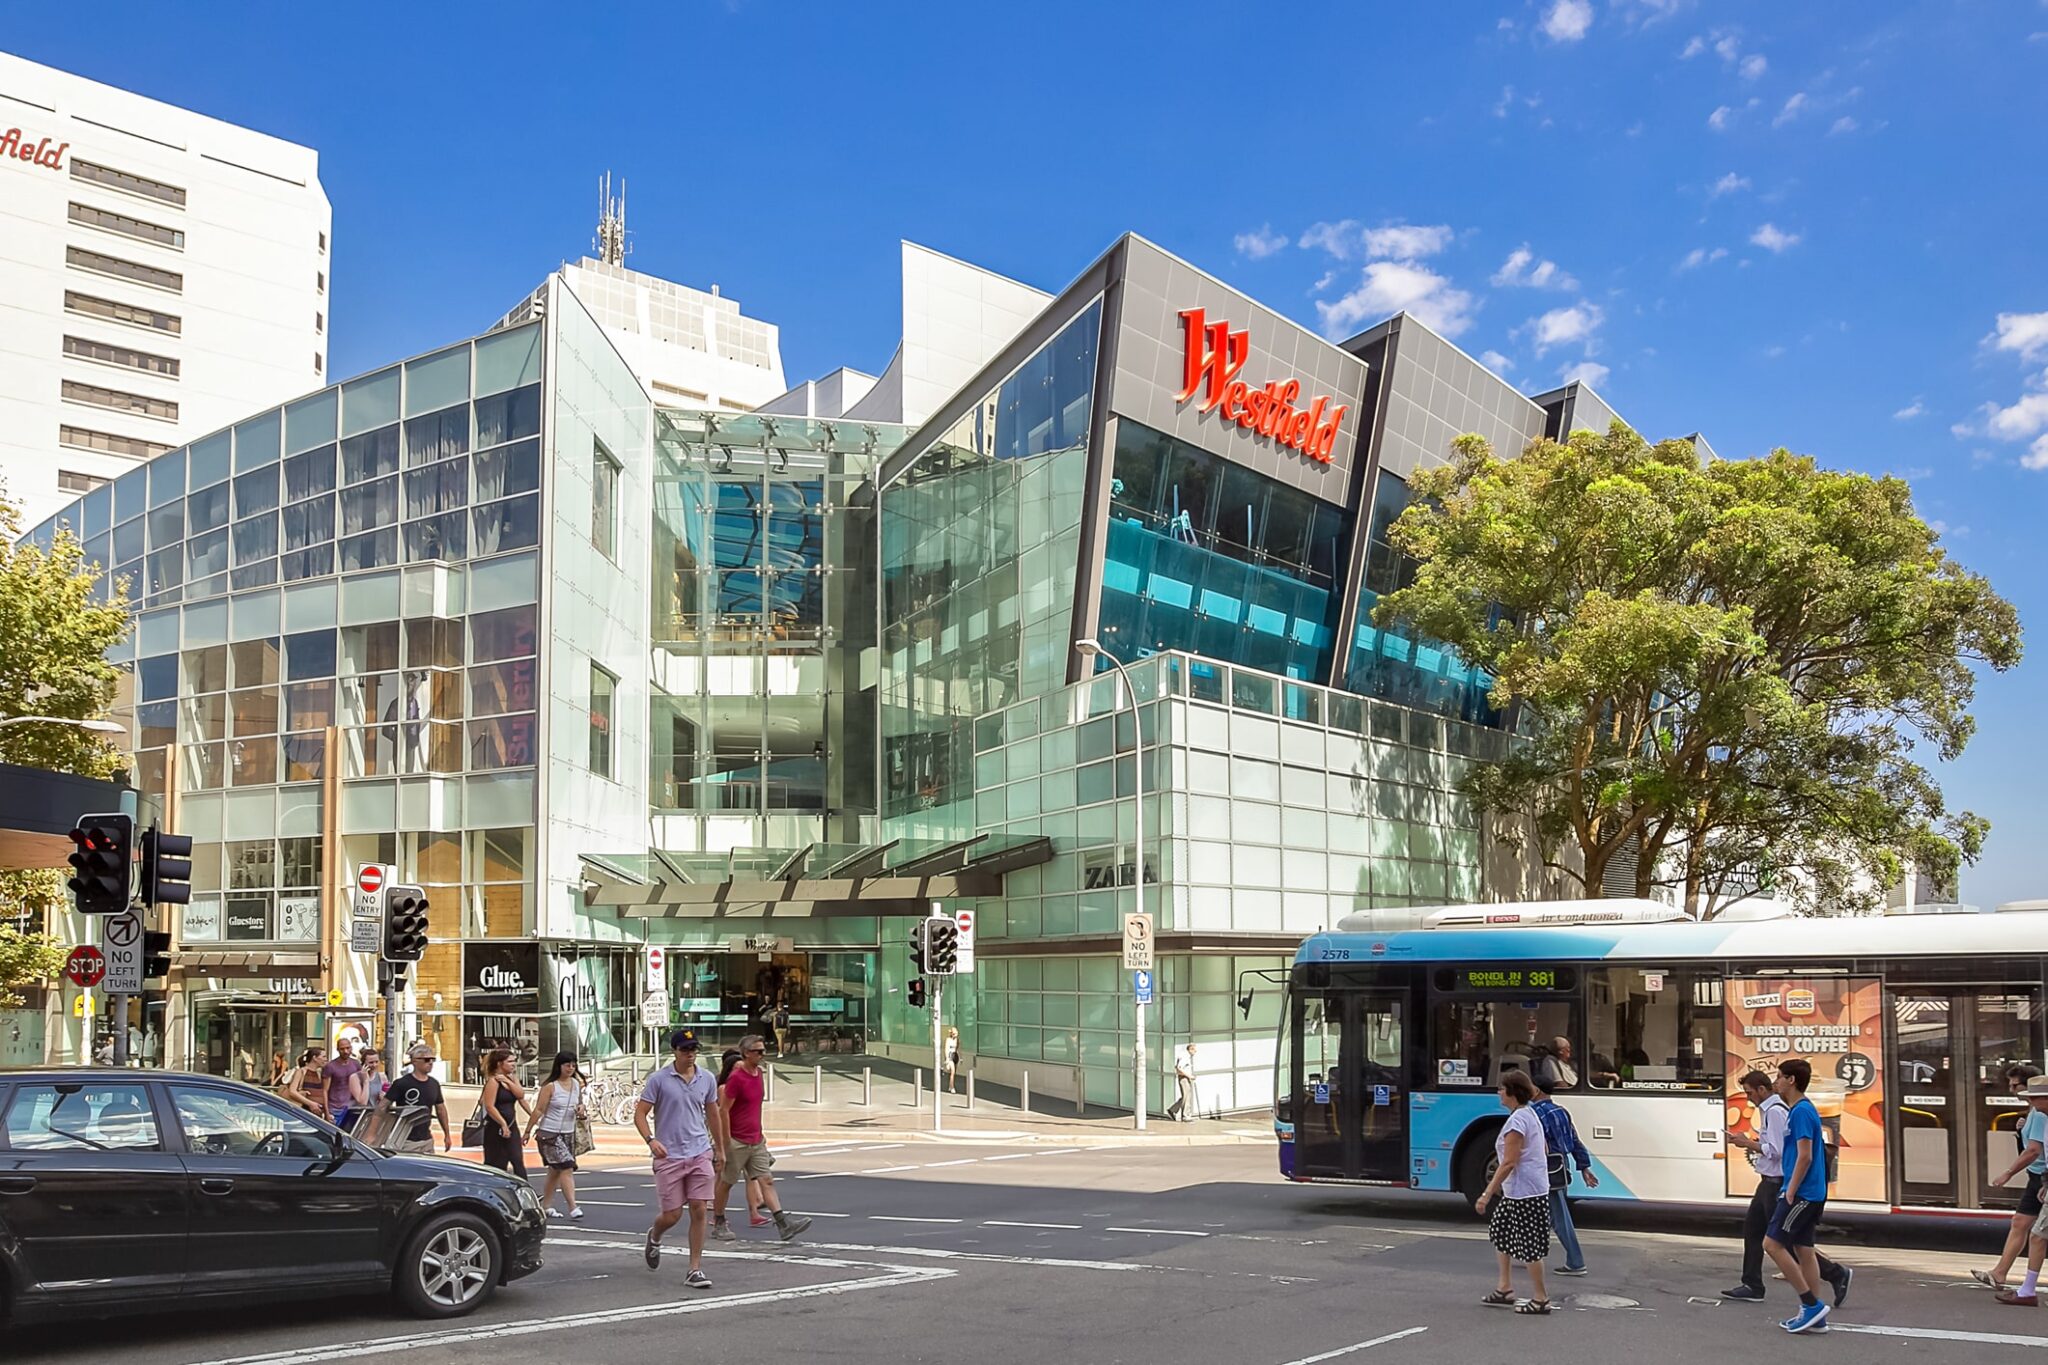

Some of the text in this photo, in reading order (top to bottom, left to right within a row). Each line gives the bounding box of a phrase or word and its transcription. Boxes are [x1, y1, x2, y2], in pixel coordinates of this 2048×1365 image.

[1172, 306, 1350, 463] Westfield
[1085, 861, 1158, 889] ZARA
[362, 896, 376, 905] NO
[356, 906, 380, 914] ENTRY
[228, 916, 265, 926] Gluestore
[1131, 943, 1146, 951] NO
[111, 951, 133, 963] NO
[1322, 950, 1350, 960] 2578
[70, 958, 104, 973] STOP
[109, 967, 135, 976] LEFT
[480, 965, 524, 988] Glue.
[1469, 972, 1504, 980] BONDI
[108, 979, 137, 988] TURN
[1529, 971, 1555, 986] 381
[269, 977, 312, 993] Glue.
[560, 973, 596, 1012] Glue
[1745, 996, 1779, 1006] ONLY AT
[1744, 1025, 1785, 1036] BARISTA
[1819, 1025, 1860, 1036] FROZEN
[1757, 1037, 1848, 1052] ICED COFFEE
[1747, 1058, 1779, 1072] NEW
[1842, 1064, 1866, 1086] $2
[1622, 1081, 1669, 1089] EMERGENCY
